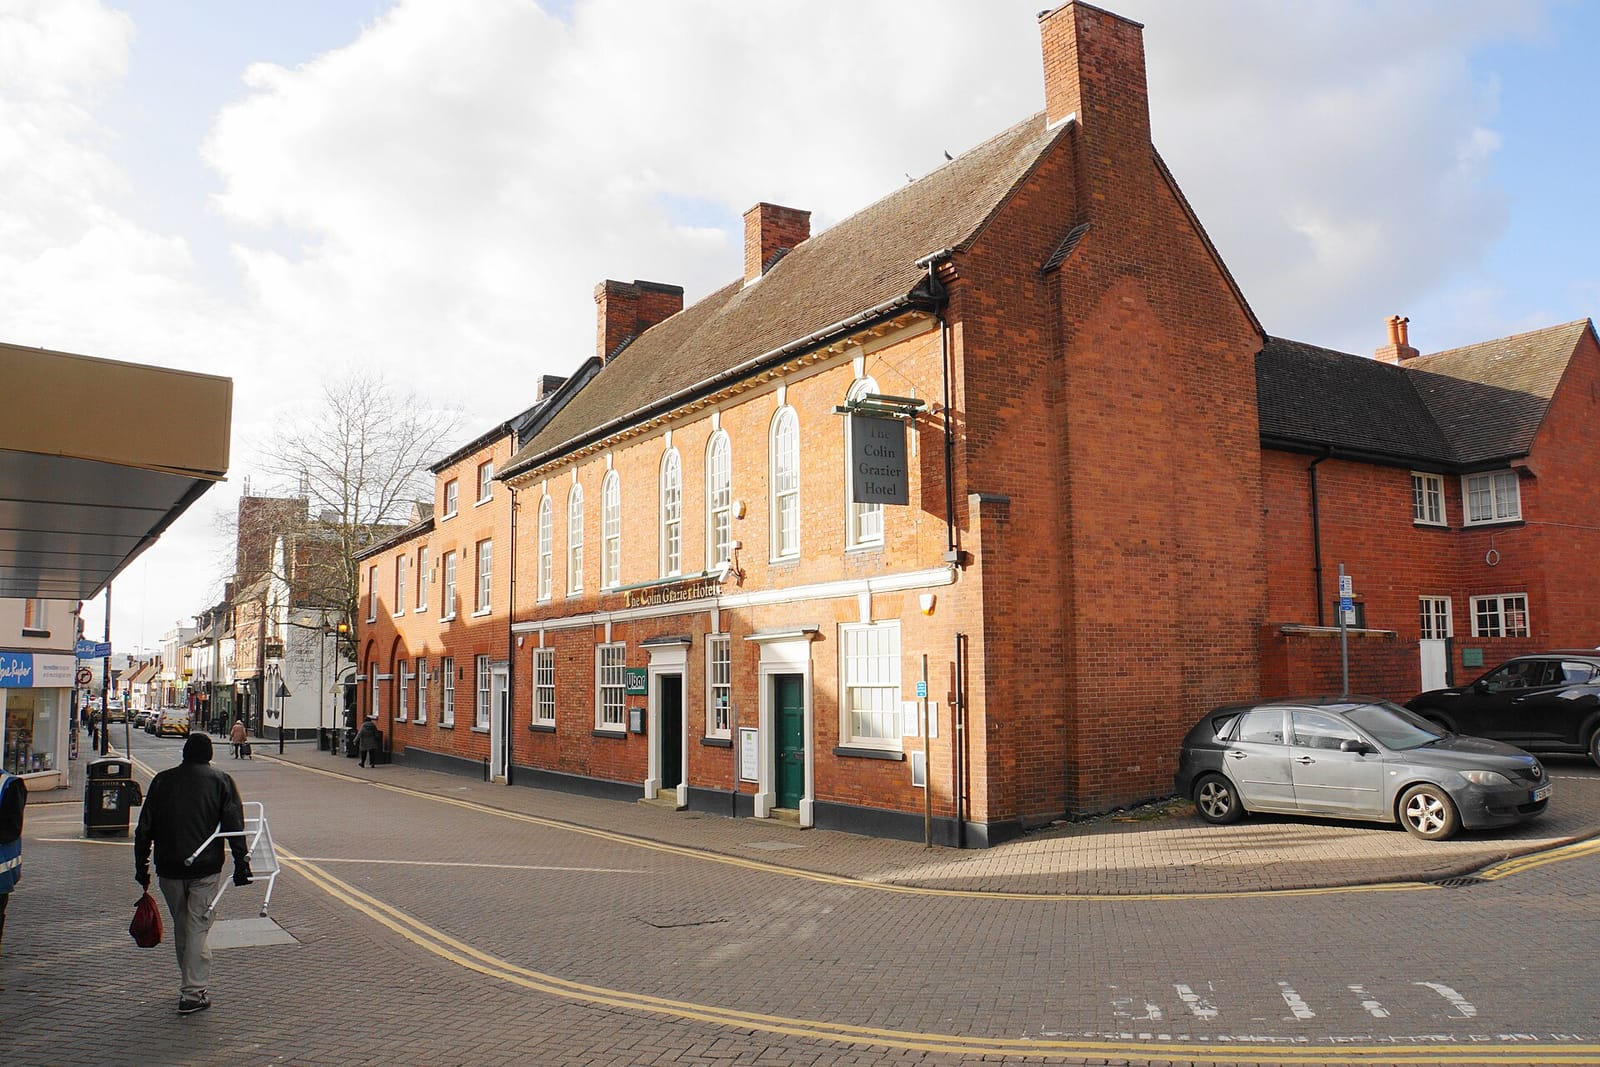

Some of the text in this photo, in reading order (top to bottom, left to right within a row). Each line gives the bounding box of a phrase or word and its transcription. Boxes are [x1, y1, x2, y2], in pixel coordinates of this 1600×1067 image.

[863, 443, 896, 458] Colin
[858, 462, 902, 477] Grazier
[865, 481, 897, 496] Hotel
[623, 578, 717, 608] The Colin Grazier Hotel
